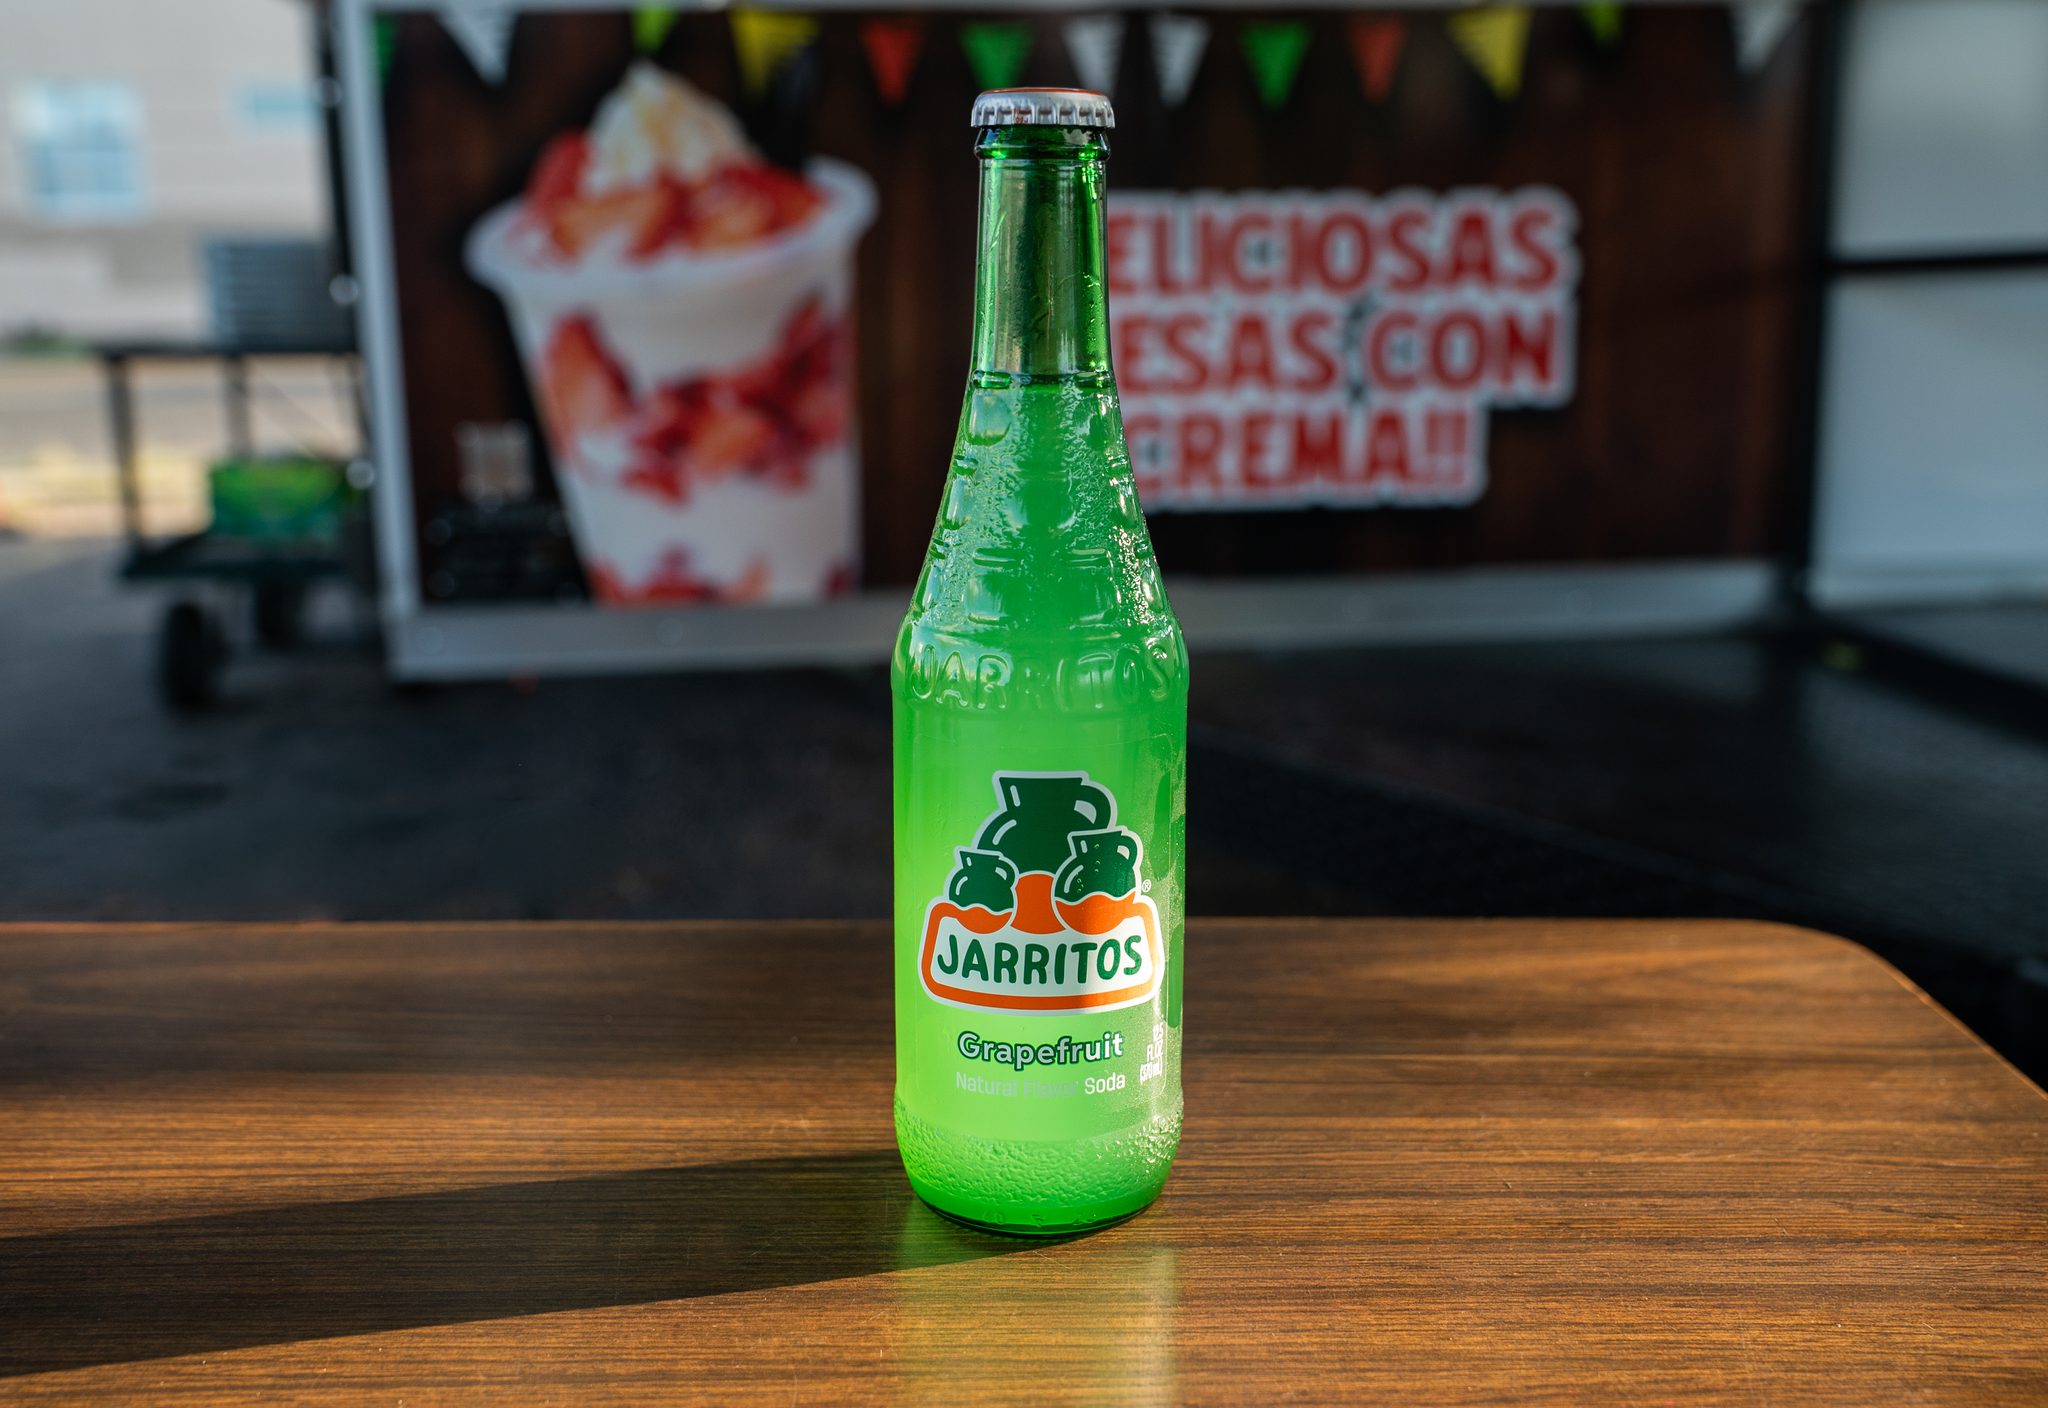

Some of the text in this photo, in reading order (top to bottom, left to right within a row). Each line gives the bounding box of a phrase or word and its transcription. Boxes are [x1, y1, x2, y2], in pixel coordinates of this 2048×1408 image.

[1107, 206, 1562, 295] ELICIOSAS
[1117, 308, 1558, 392] ESAS CON
[1127, 408, 1468, 494] CREMA!!
[937, 934, 1141, 985] JARRITOS
[956, 1071, 1126, 1098] Natural Flavor Soda
[958, 1031, 1124, 1071] Grapefruit
